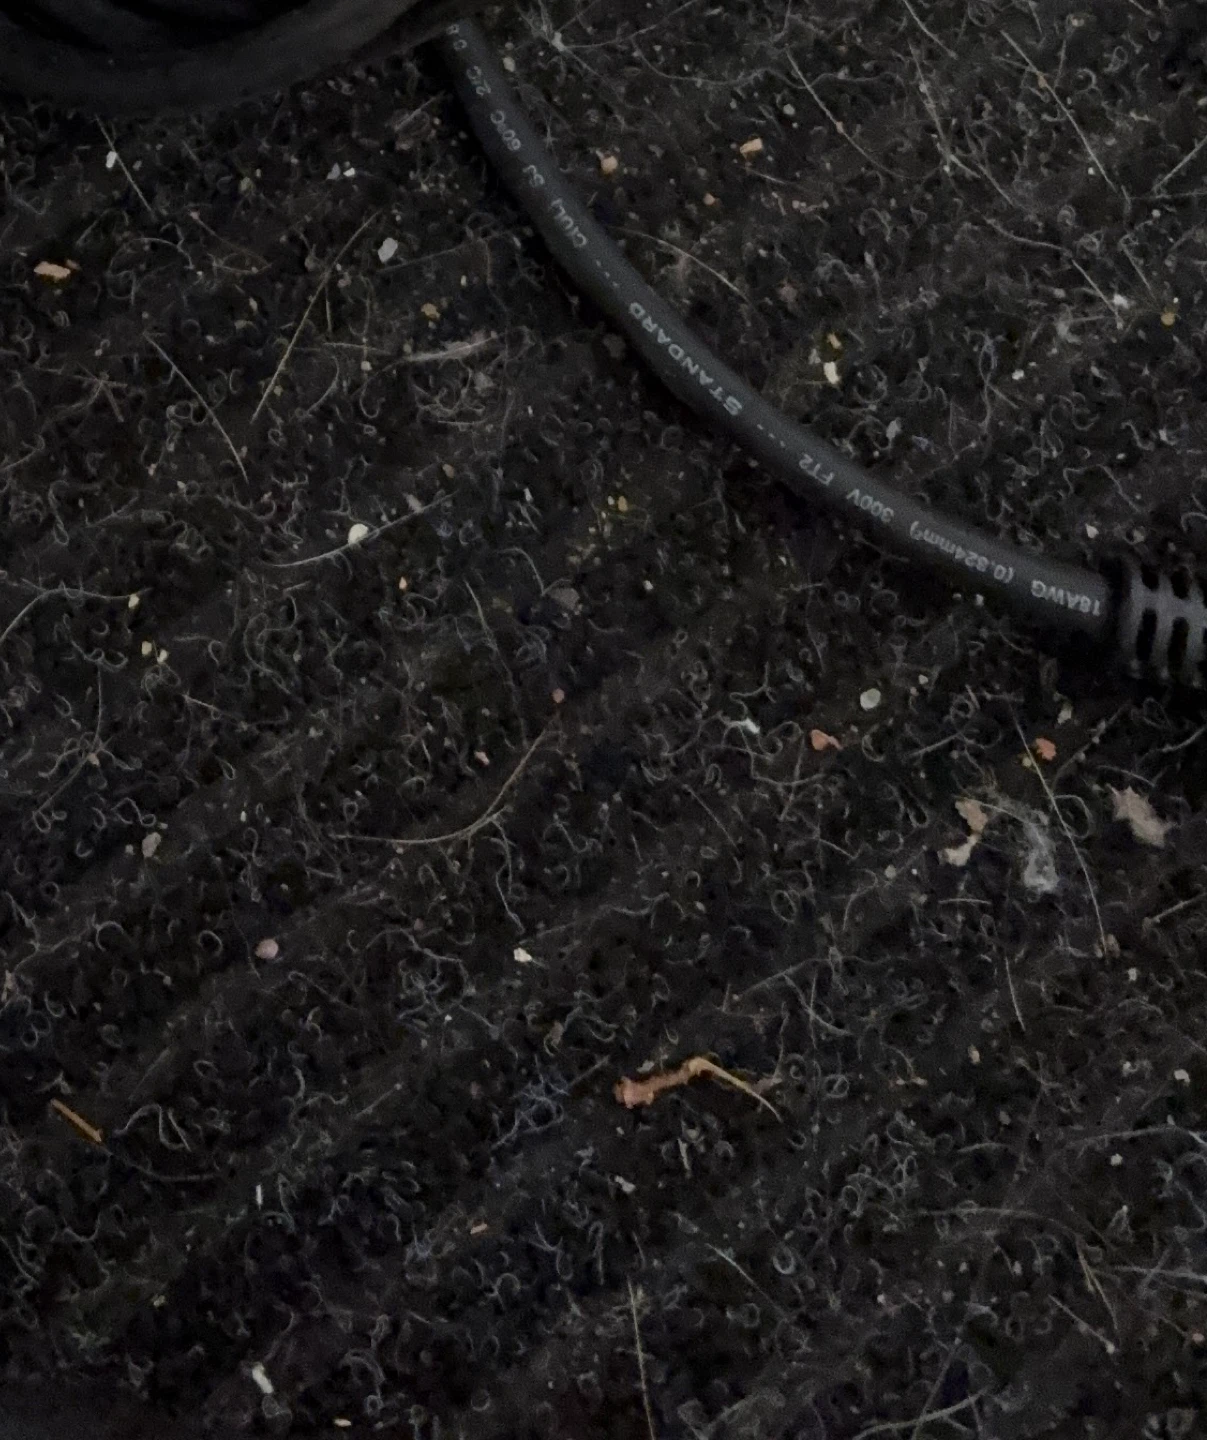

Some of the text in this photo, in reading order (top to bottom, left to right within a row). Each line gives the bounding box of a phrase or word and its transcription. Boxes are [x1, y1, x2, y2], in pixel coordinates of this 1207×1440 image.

[523, 164, 546, 188] SJ
[628, 301, 743, 417] STANDARD
[798, 453, 835, 487] FT2
[845, 488, 895, 524] 300V
[1030, 578, 1101, 617] 18AWG
